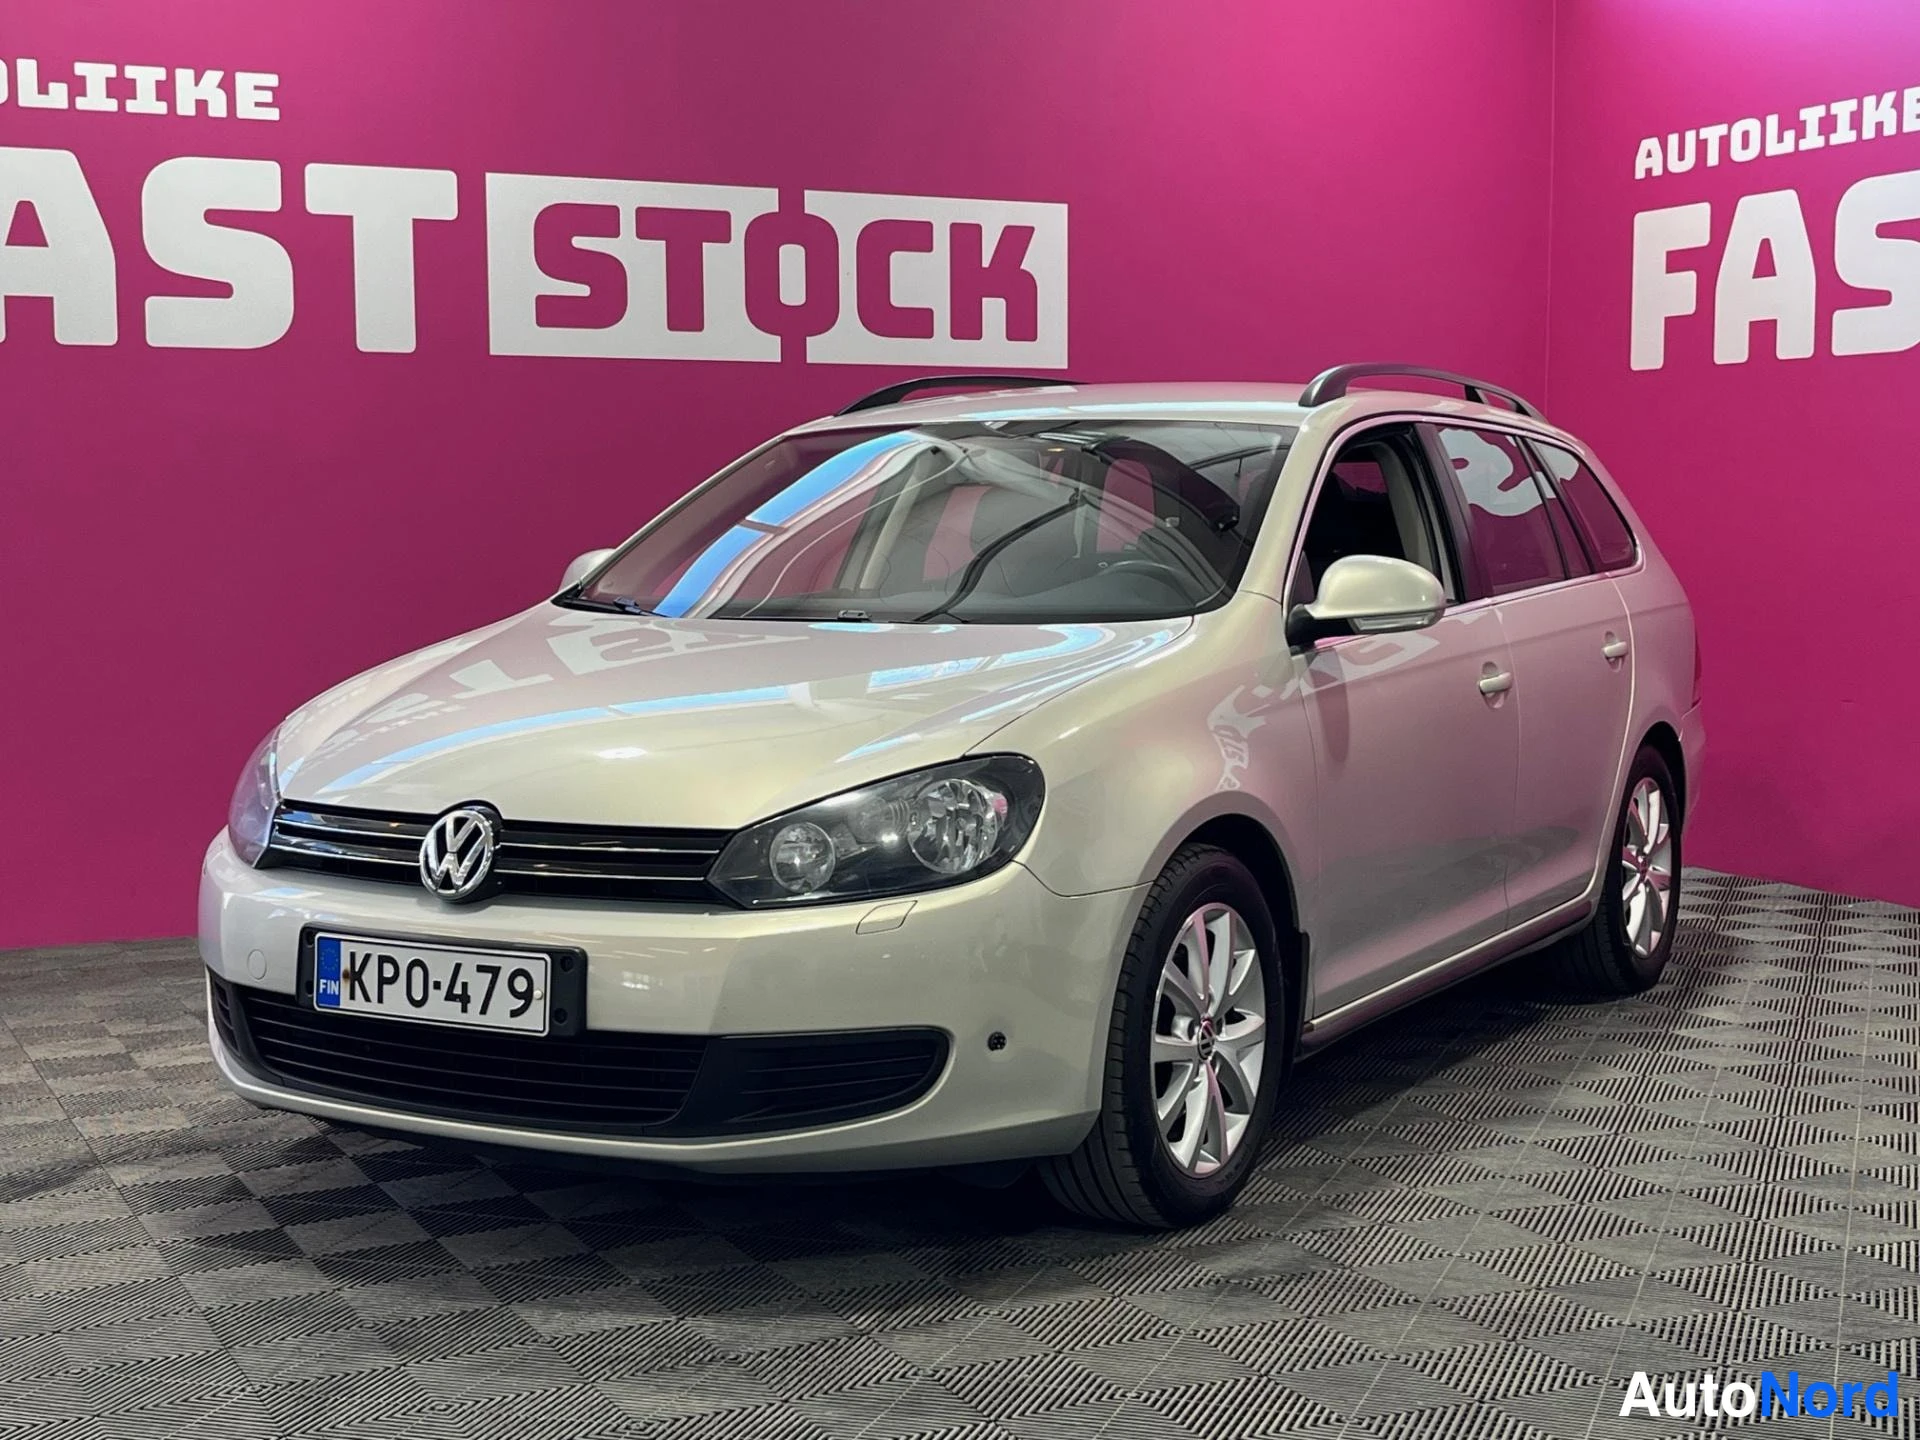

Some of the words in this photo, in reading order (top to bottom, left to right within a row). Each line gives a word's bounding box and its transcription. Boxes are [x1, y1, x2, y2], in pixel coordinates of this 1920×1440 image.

[0, 58, 281, 121] LIIKE
[1634, 86, 1920, 180] AUTOLIIKE
[533, 202, 1039, 342] STOCK
[419, 809, 495, 900] VW
[318, 977, 339, 996] FIN
[348, 950, 535, 1019] KPO-479
